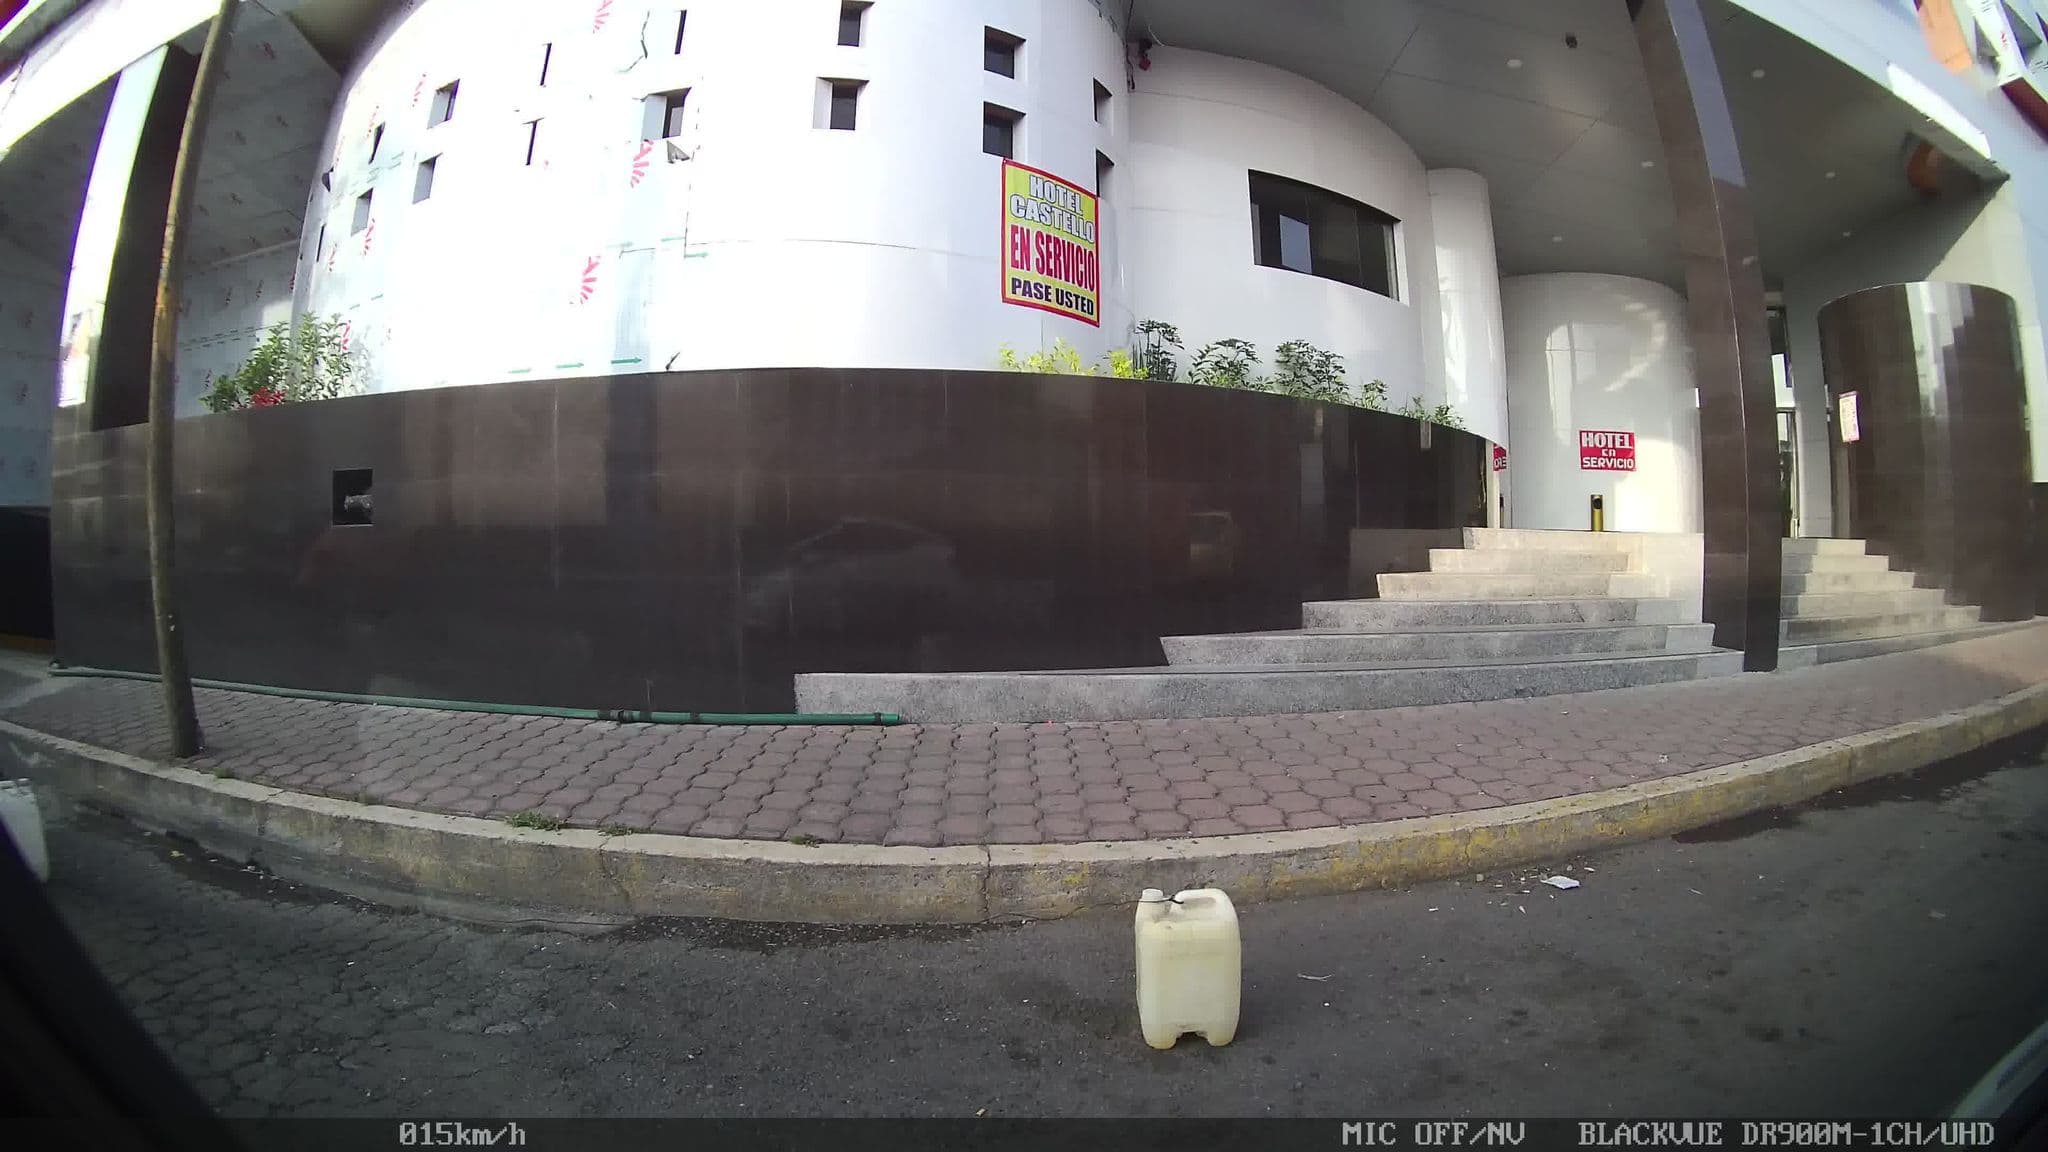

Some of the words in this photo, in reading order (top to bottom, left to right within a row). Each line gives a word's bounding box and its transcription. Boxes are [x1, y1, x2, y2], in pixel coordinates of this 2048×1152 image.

[1029, 174, 1083, 215] HOTEL
[1010, 194, 1095, 244] CASTELLO
[1011, 224, 1031, 271] EN
[1035, 230, 1096, 292] SERVICIO
[1011, 277, 1052, 302] PASE
[1055, 287, 1094, 315] USTED
[1581, 432, 1632, 449] HOTEL
[1583, 457, 1634, 469] SERVICIO
